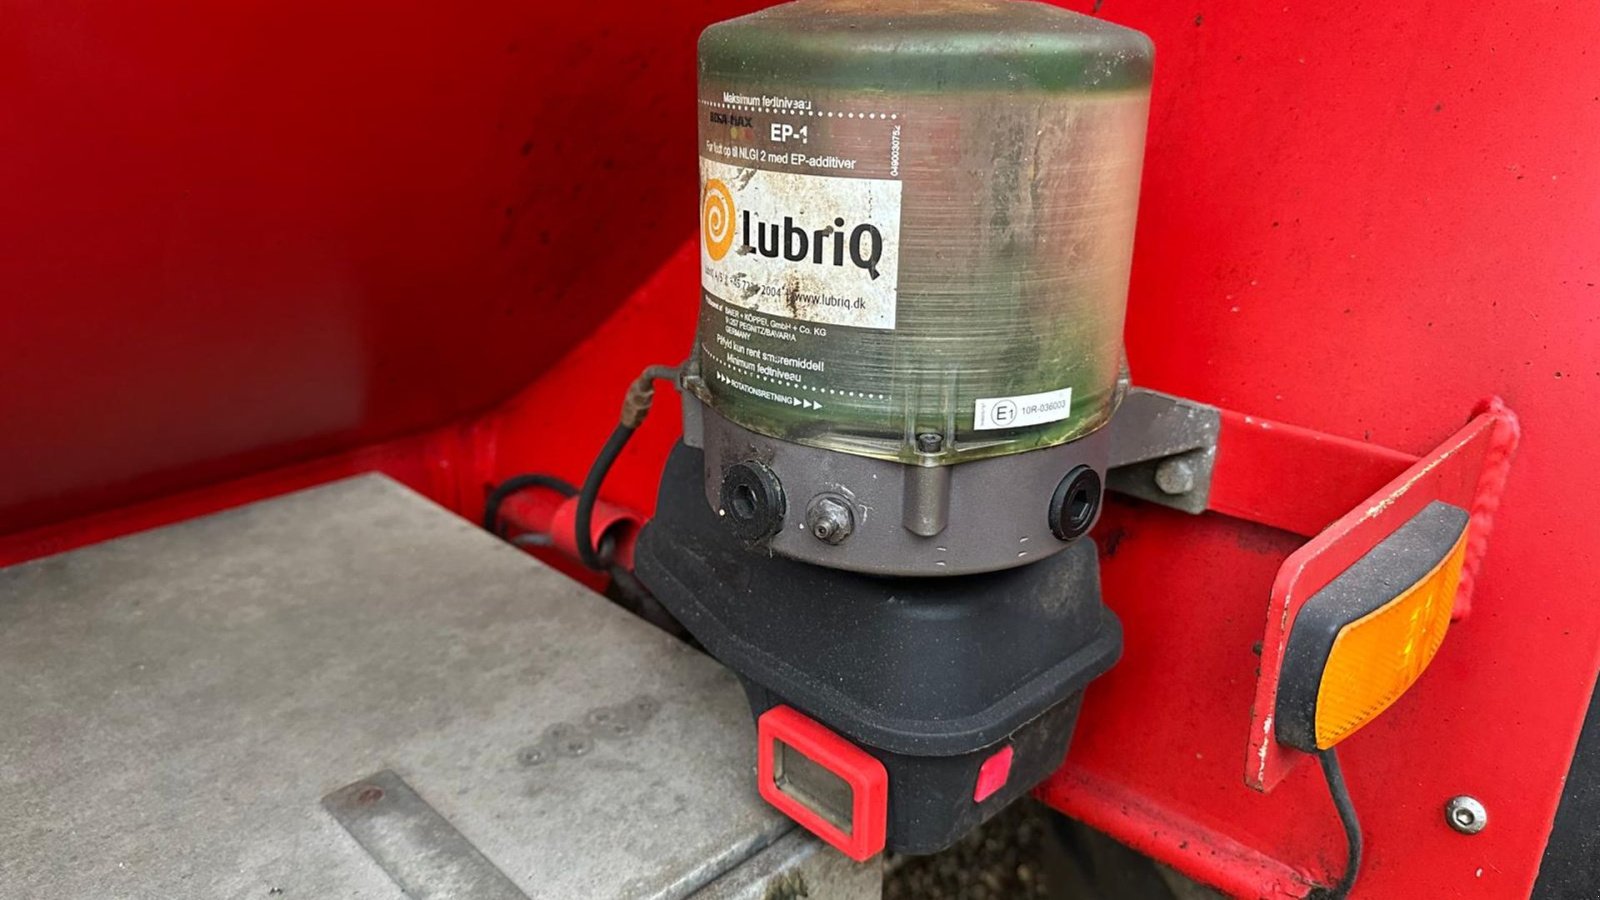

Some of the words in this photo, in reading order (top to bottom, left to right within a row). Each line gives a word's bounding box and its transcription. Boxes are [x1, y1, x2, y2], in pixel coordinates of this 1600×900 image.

[723, 91, 761, 107] Maksimum
[770, 123, 808, 144] EP-1
[739, 148, 759, 161] NLGI
[760, 150, 767, 162] 2
[768, 153, 788, 165] med
[791, 153, 856, 170] EP-additiver
[742, 210, 883, 280] LubriQ
[761, 284, 781, 297] 2004
[795, 292, 866, 311] www.lubriq.dk
[770, 319, 792, 331] GmbH
[813, 328, 827, 337] KG
[1022, 400, 1067, 415] 10R-036003
